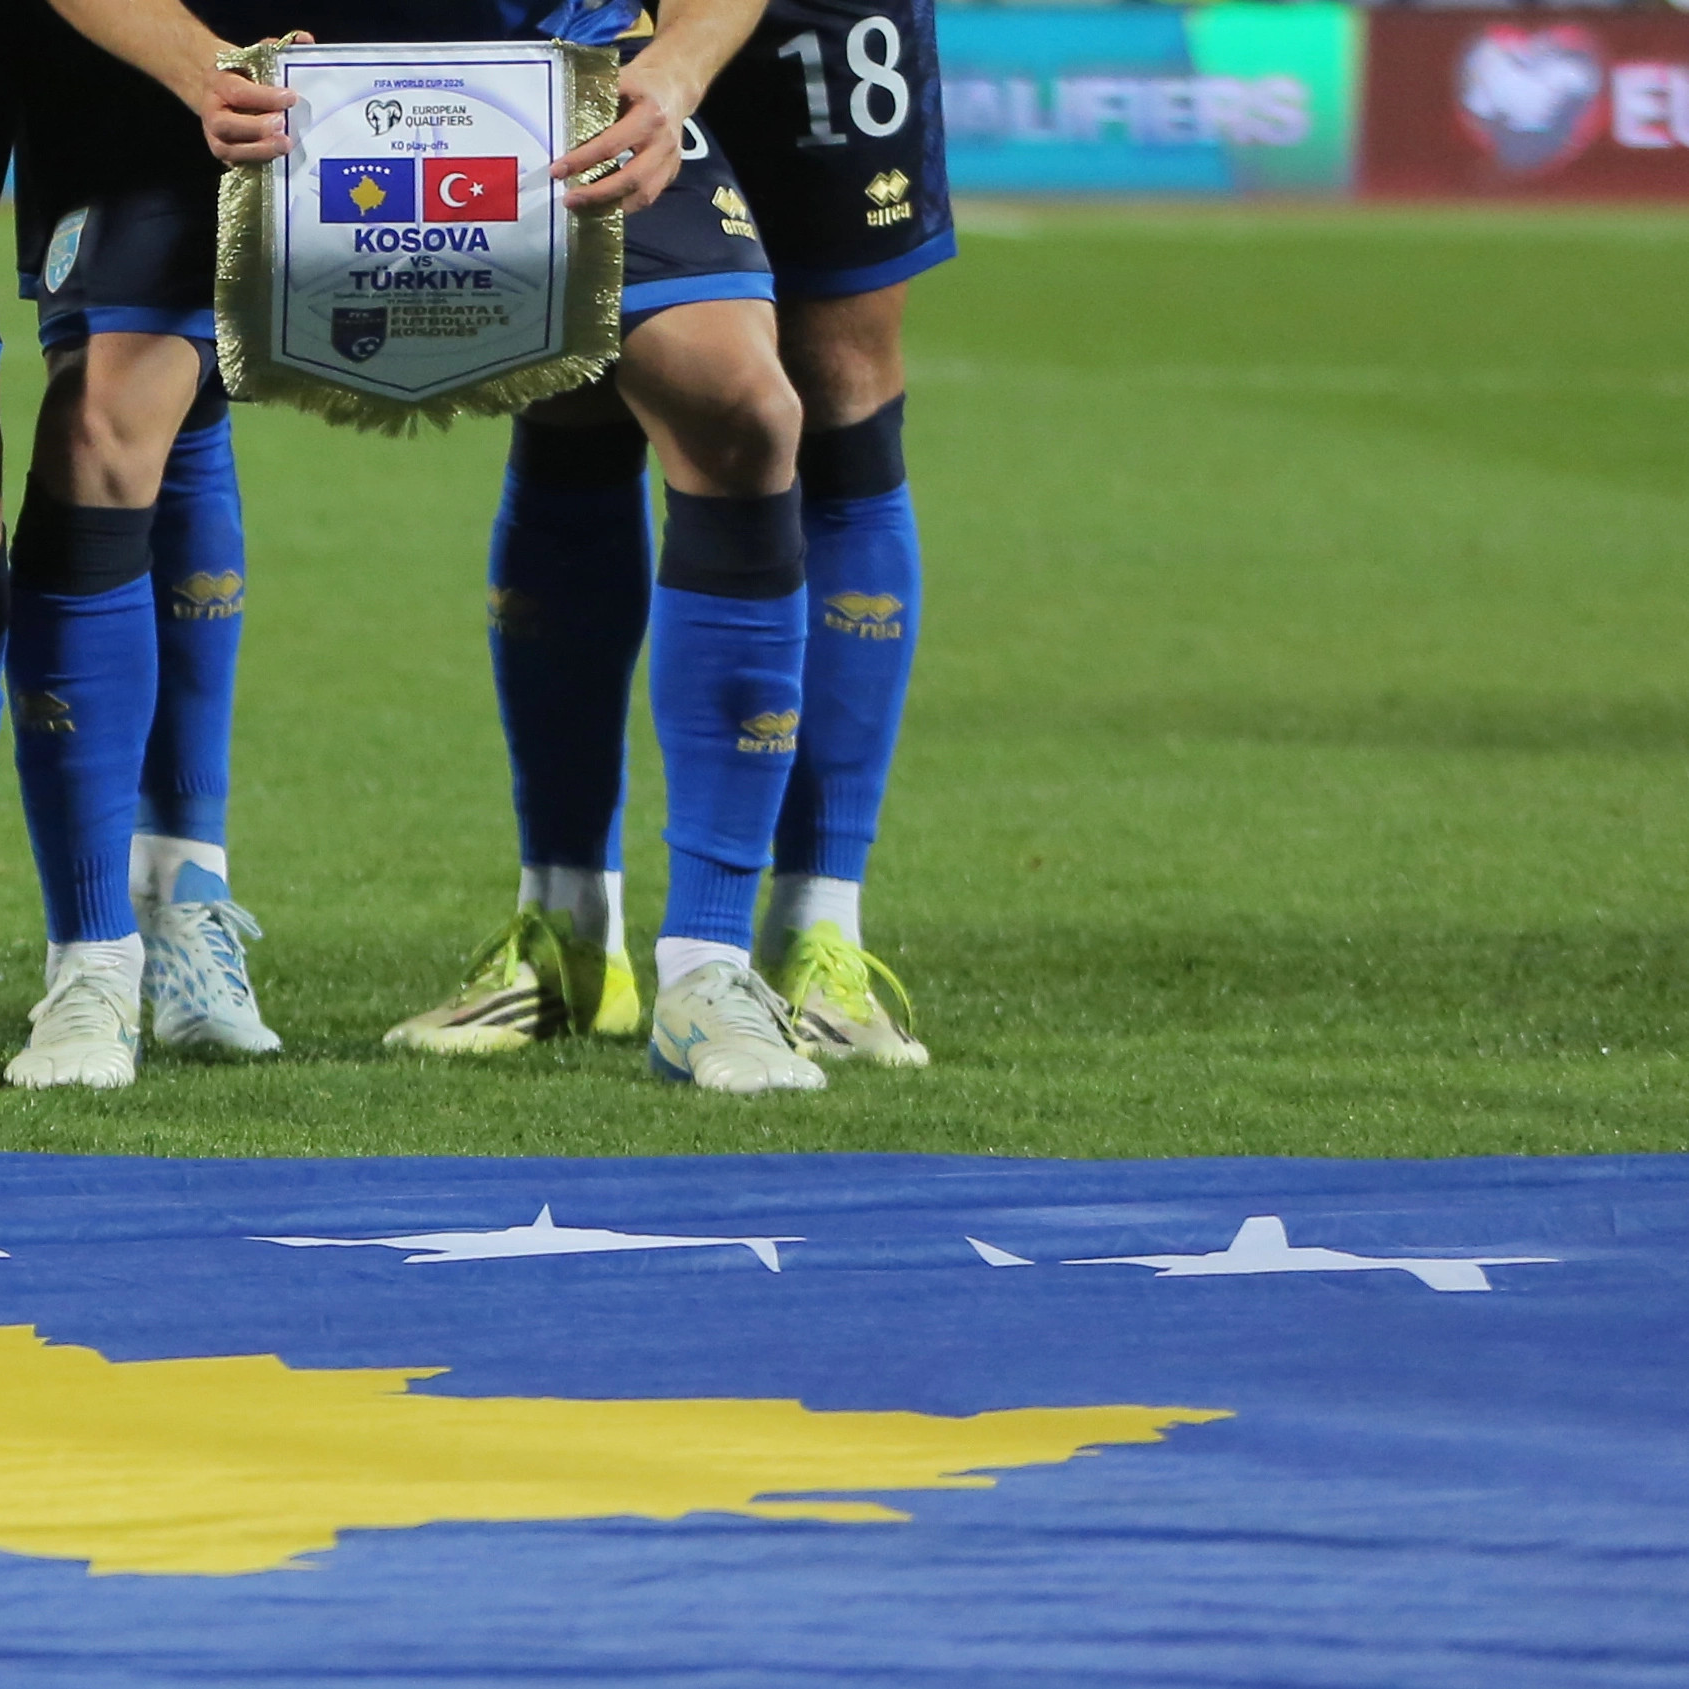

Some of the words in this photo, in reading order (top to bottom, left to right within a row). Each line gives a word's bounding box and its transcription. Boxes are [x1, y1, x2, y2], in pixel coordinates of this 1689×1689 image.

[374, 79, 392, 88] FIFA
[393, 79, 423, 88] WORLD
[425, 79, 441, 88] CUP
[443, 79, 464, 88] 2026
[778, 15, 910, 150] 18
[412, 105, 466, 115] EUROPEAN
[405, 115, 473, 128] QUALIFIERS
[406, 140, 449, 152] play-offs
[866, 201, 912, 228] errea
[354, 227, 490, 253] KOSOVA
[349, 266, 493, 291] TÜRKIYE
